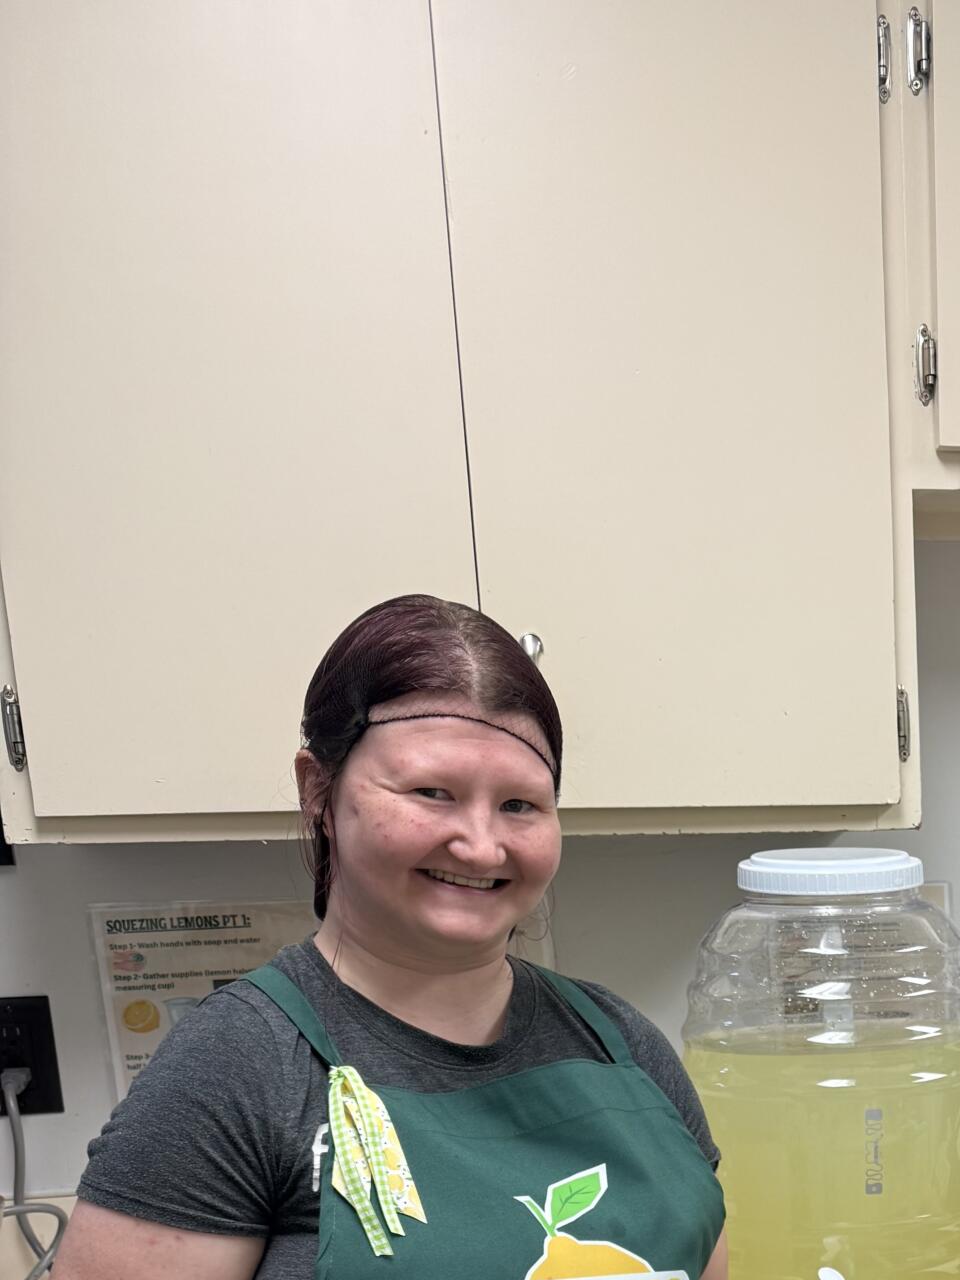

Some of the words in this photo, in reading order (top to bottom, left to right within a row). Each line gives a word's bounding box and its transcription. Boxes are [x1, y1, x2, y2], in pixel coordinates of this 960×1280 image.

[106, 918, 167, 933] SQUEZING
[170, 915, 220, 930] LEMONS
[222, 914, 238, 928] PT
[142, 972, 169, 980] Gather
[170, 970, 203, 979] supplies
